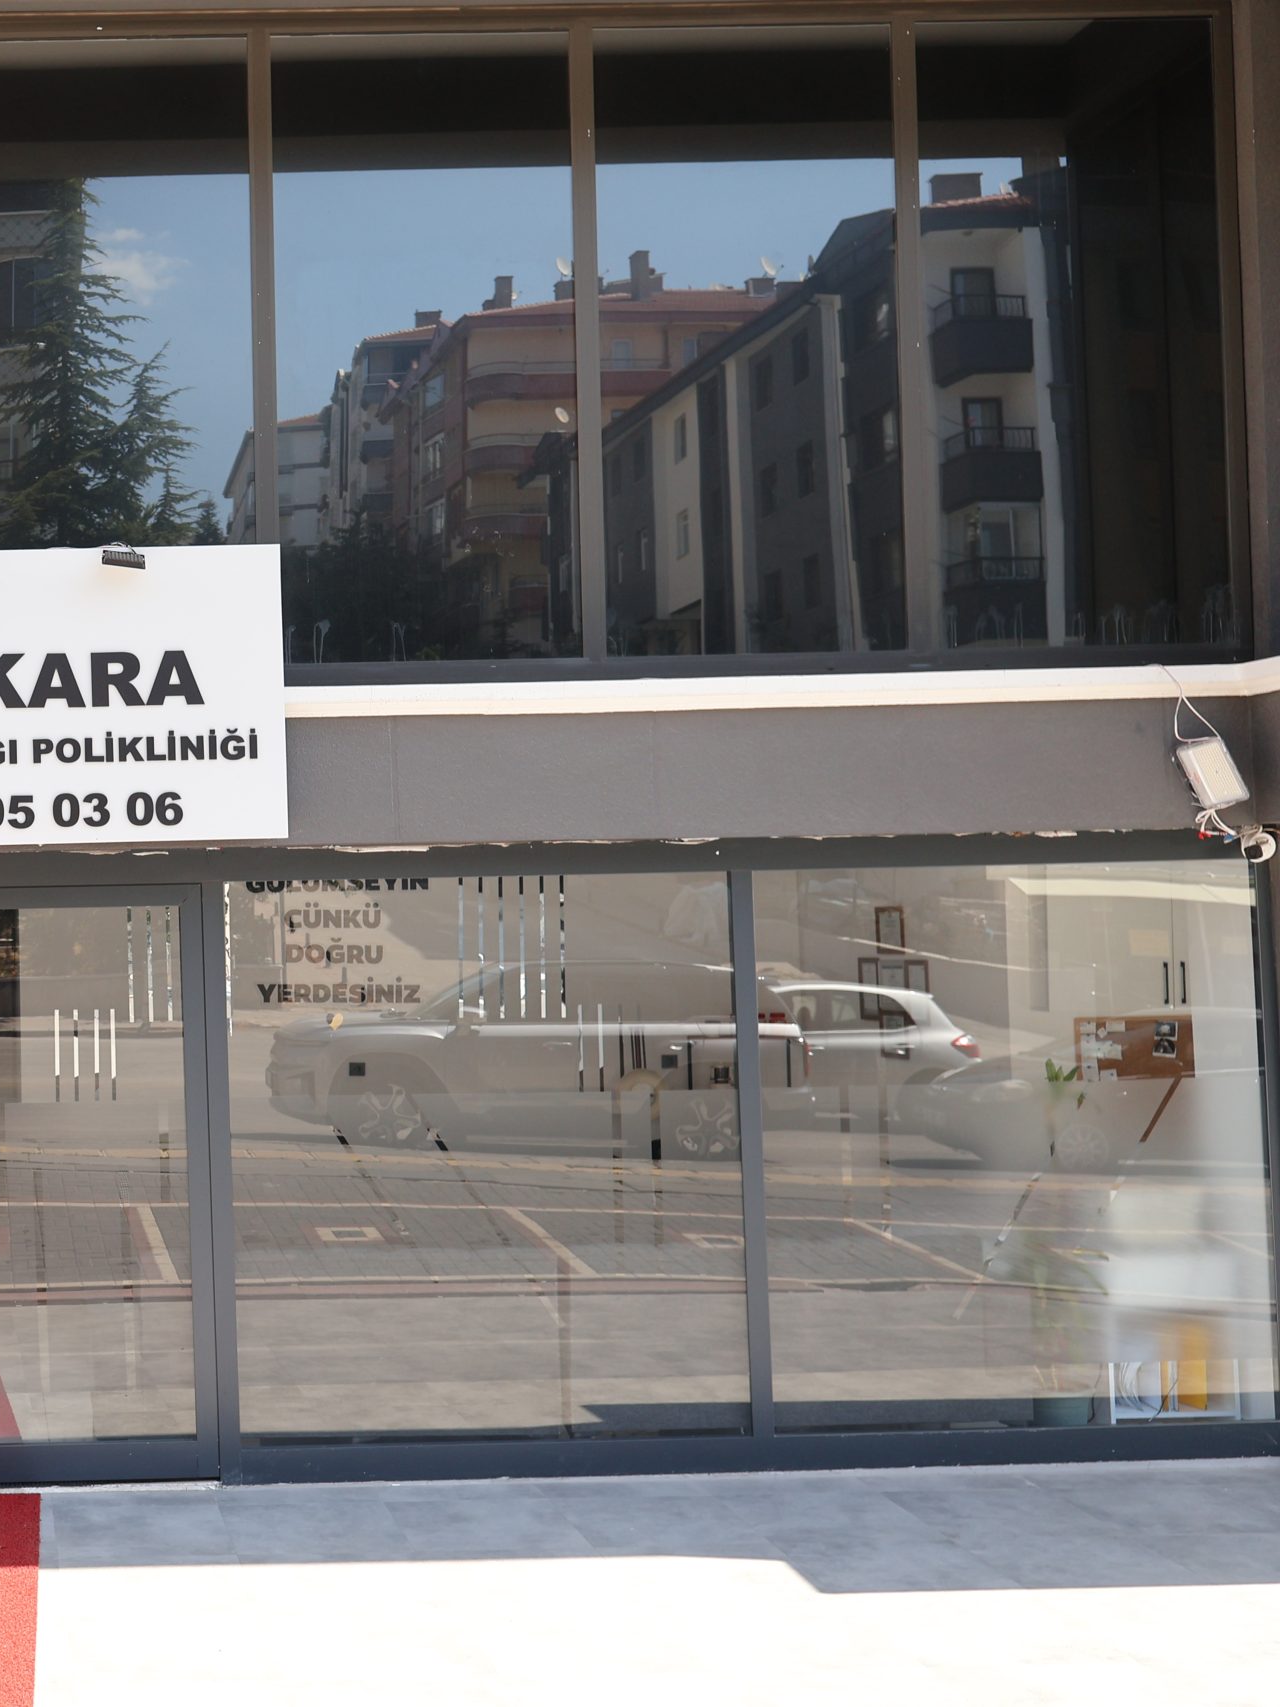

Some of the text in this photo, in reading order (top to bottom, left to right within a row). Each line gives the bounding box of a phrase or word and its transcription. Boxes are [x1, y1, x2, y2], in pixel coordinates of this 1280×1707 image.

[32, 728, 258, 764] POLİKLİNİĞİ
[52, 792, 111, 828] 03
[126, 791, 184, 827] 06
[284, 902, 381, 933] ÇÜNKÜ
[286, 937, 384, 964] DOĞRU
[257, 976, 421, 1004] YERDESİNİZ
